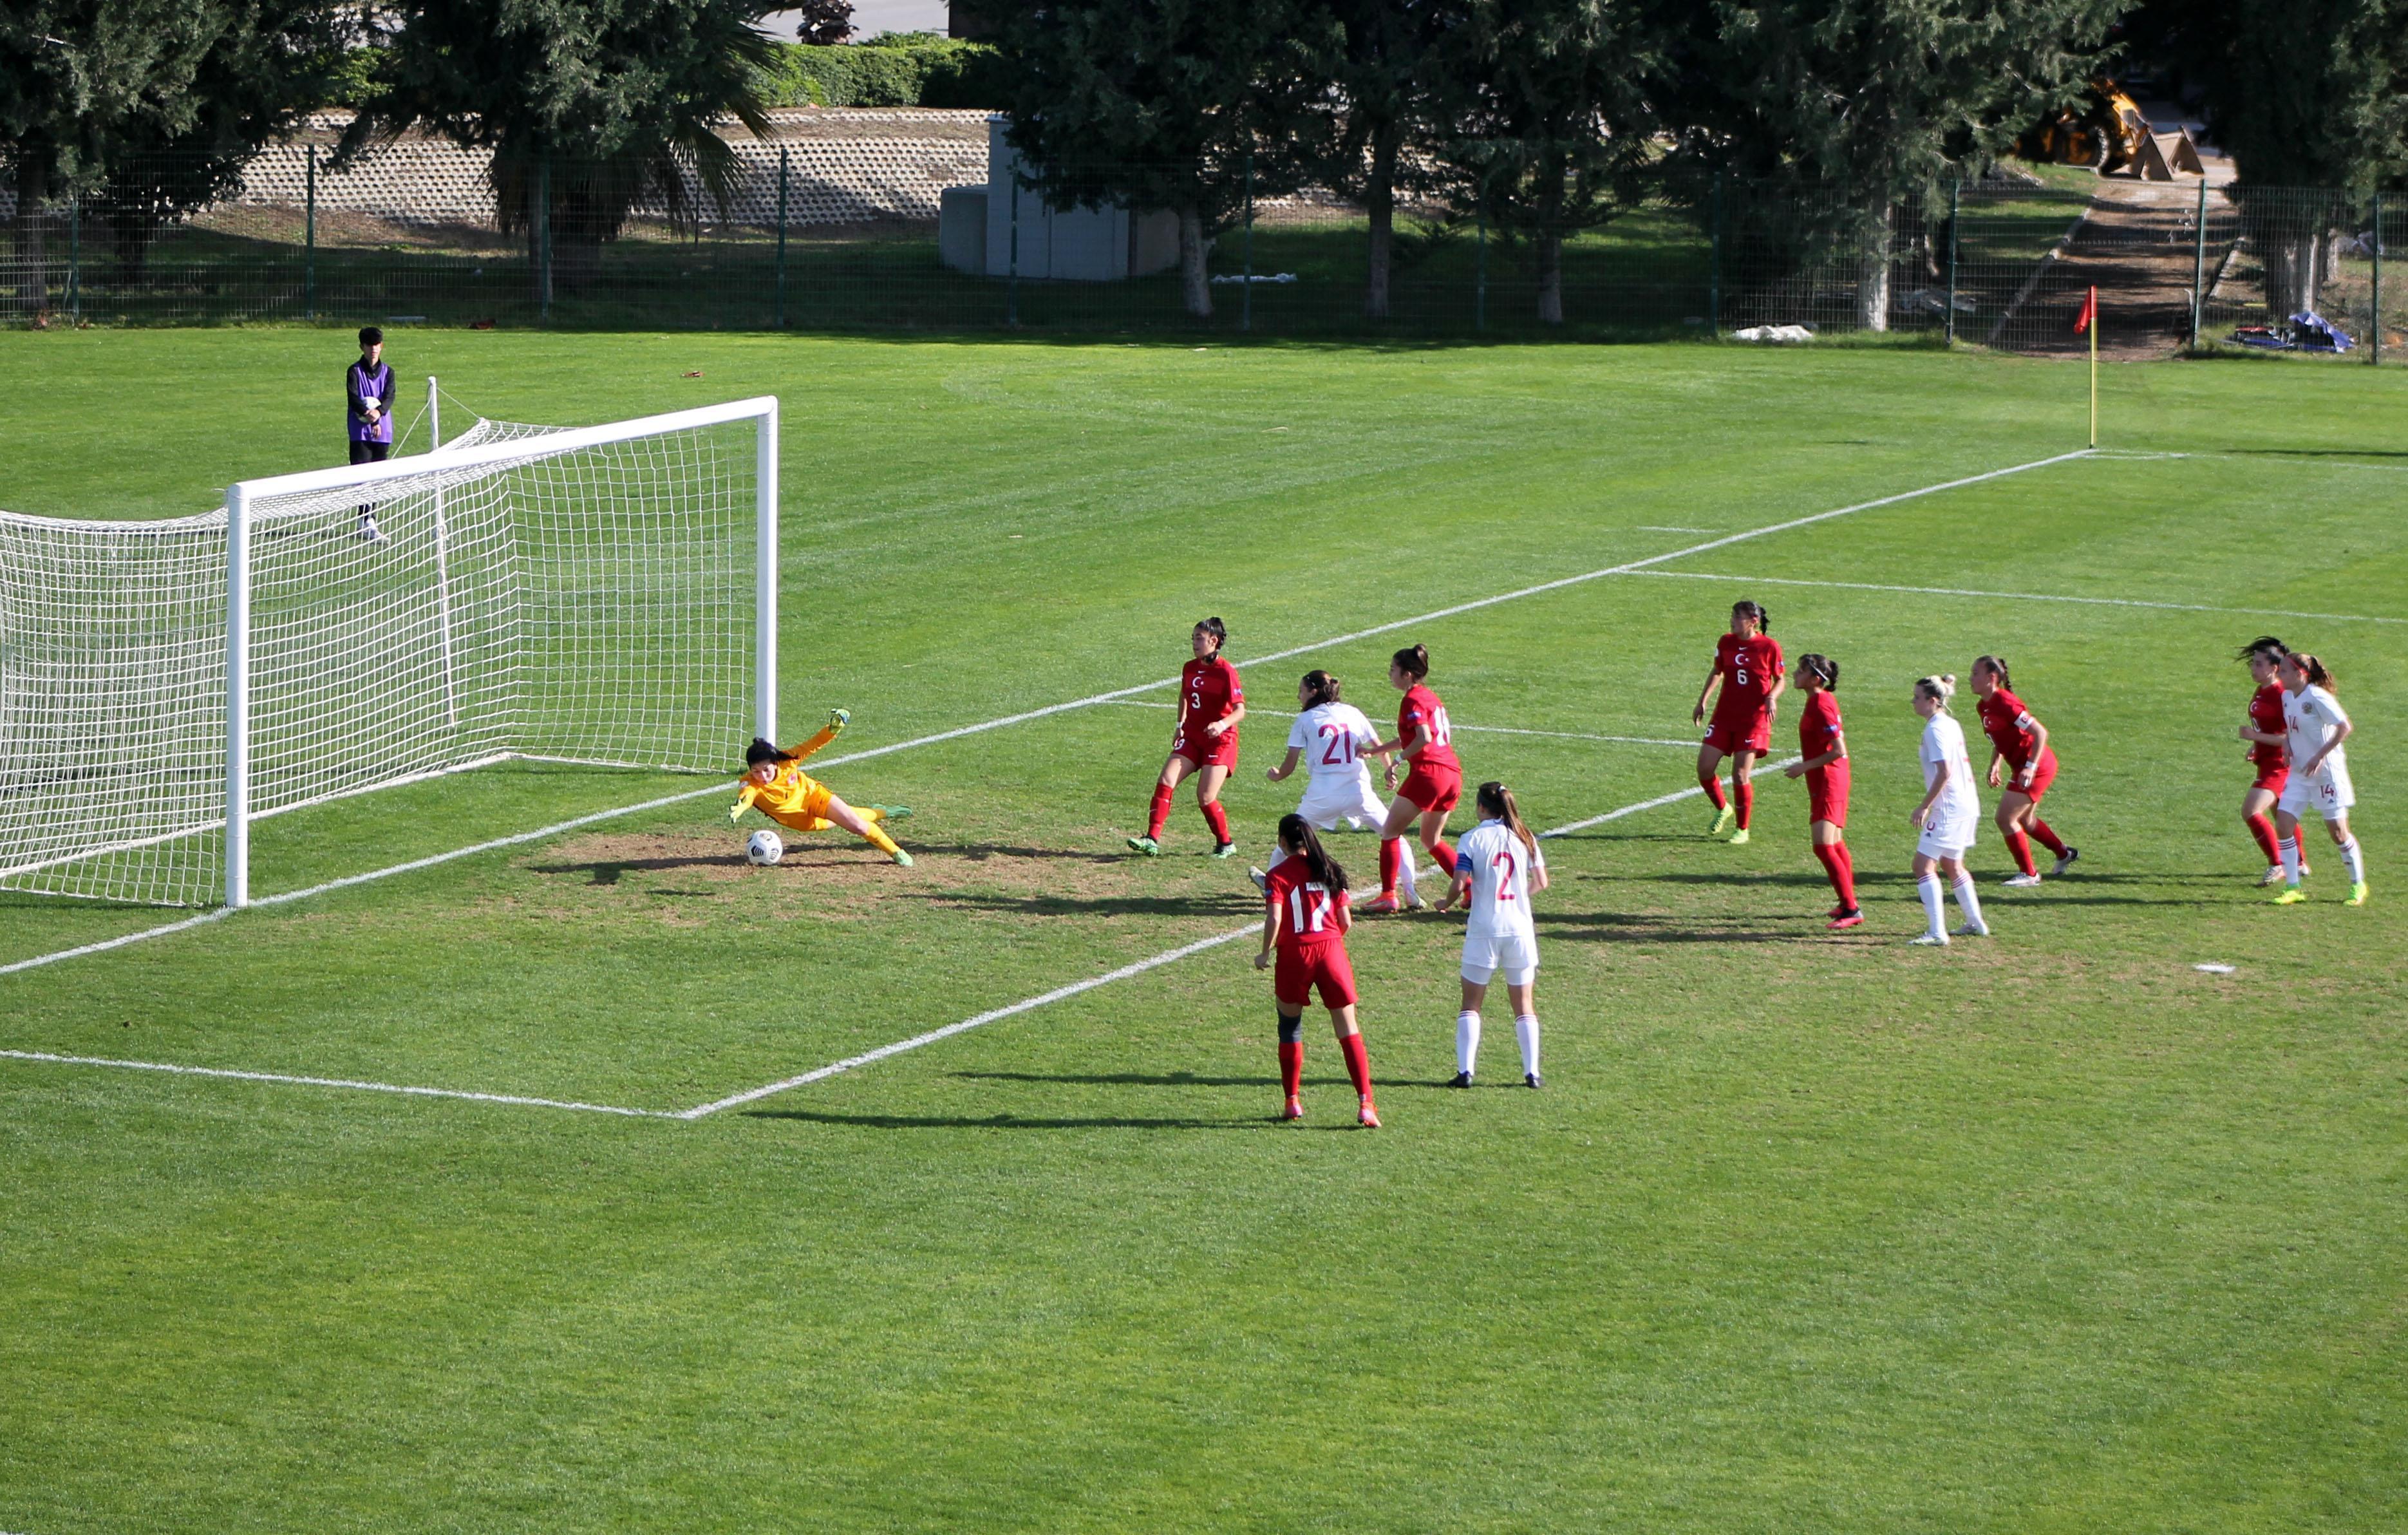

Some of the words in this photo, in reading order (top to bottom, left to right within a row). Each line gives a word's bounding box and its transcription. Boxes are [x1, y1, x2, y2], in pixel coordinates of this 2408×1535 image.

[1736, 669, 1747, 685] 6
[1191, 692, 1201, 709] 3
[2288, 715, 2299, 733] 14
[1317, 722, 1351, 765] 21
[2320, 784, 2335, 798] 14
[1492, 851, 1516, 901] 2
[1290, 881, 1331, 934] 17
